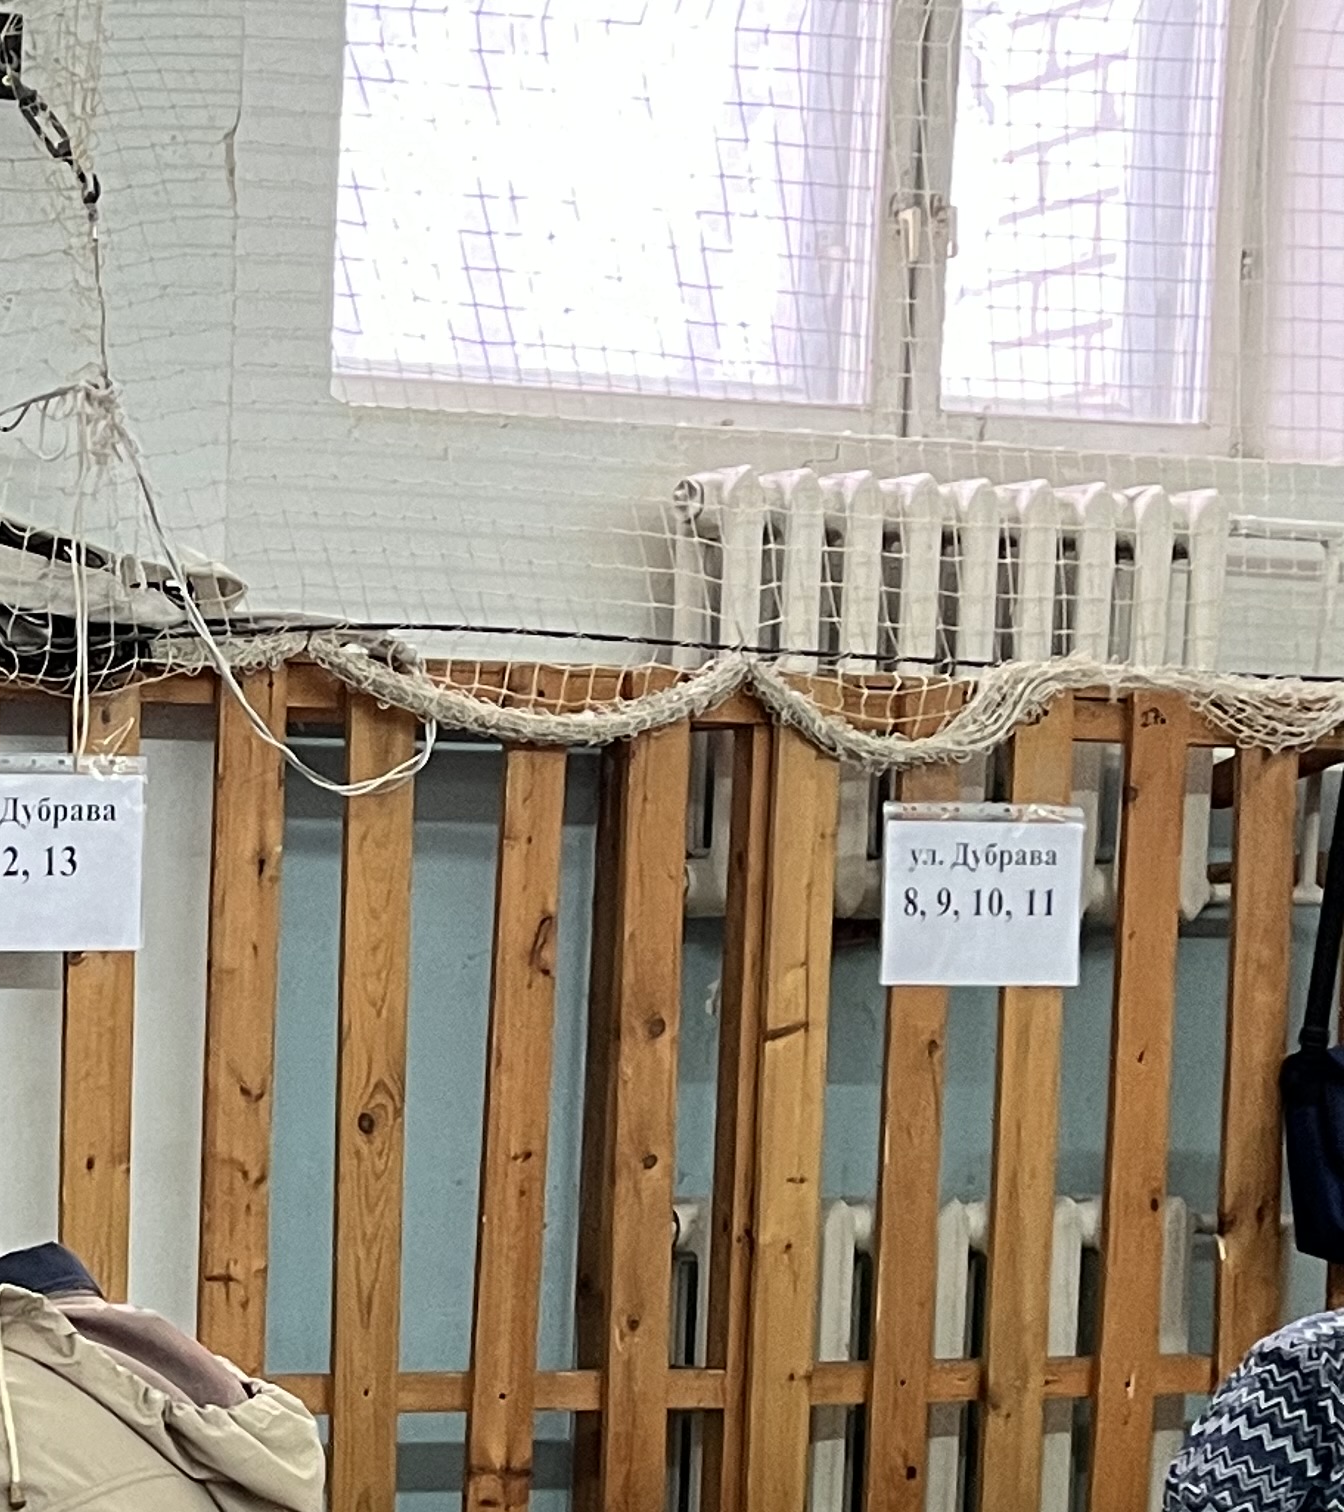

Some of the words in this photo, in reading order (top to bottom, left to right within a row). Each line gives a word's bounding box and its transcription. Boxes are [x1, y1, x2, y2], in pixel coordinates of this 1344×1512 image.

[43, 845, 78, 877] 13
[908, 848, 945, 873] ул.
[949, 842, 1057, 874] Дубрава
[903, 886, 927, 923] 8,
[936, 887, 961, 923] 9,
[972, 887, 1013, 922] 10,
[1026, 888, 1054, 917] 11
